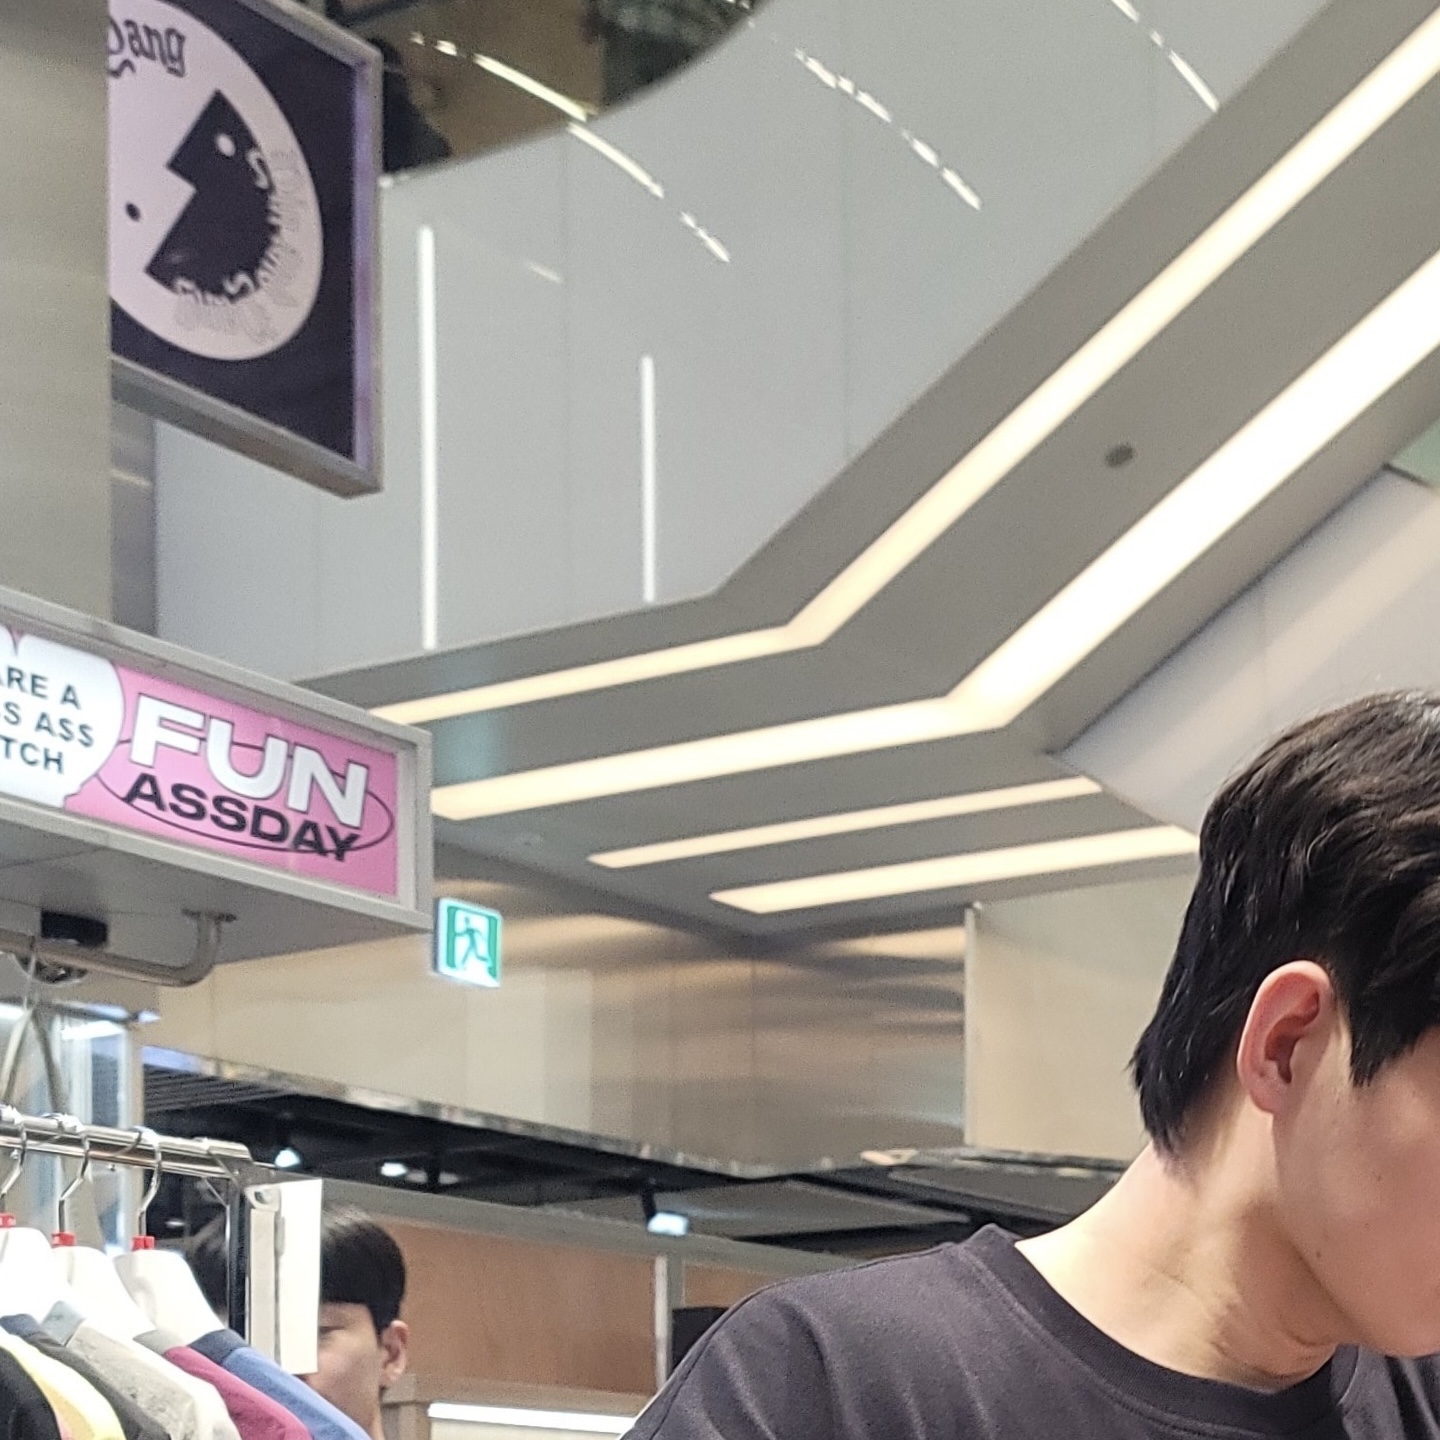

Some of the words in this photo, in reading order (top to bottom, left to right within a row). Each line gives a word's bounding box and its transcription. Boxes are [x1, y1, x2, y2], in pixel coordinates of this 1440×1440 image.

[60, 683, 82, 711] A
[34, 711, 95, 748] ASS
[129, 693, 370, 830] FUN
[122, 772, 361, 862] ASSDAY
